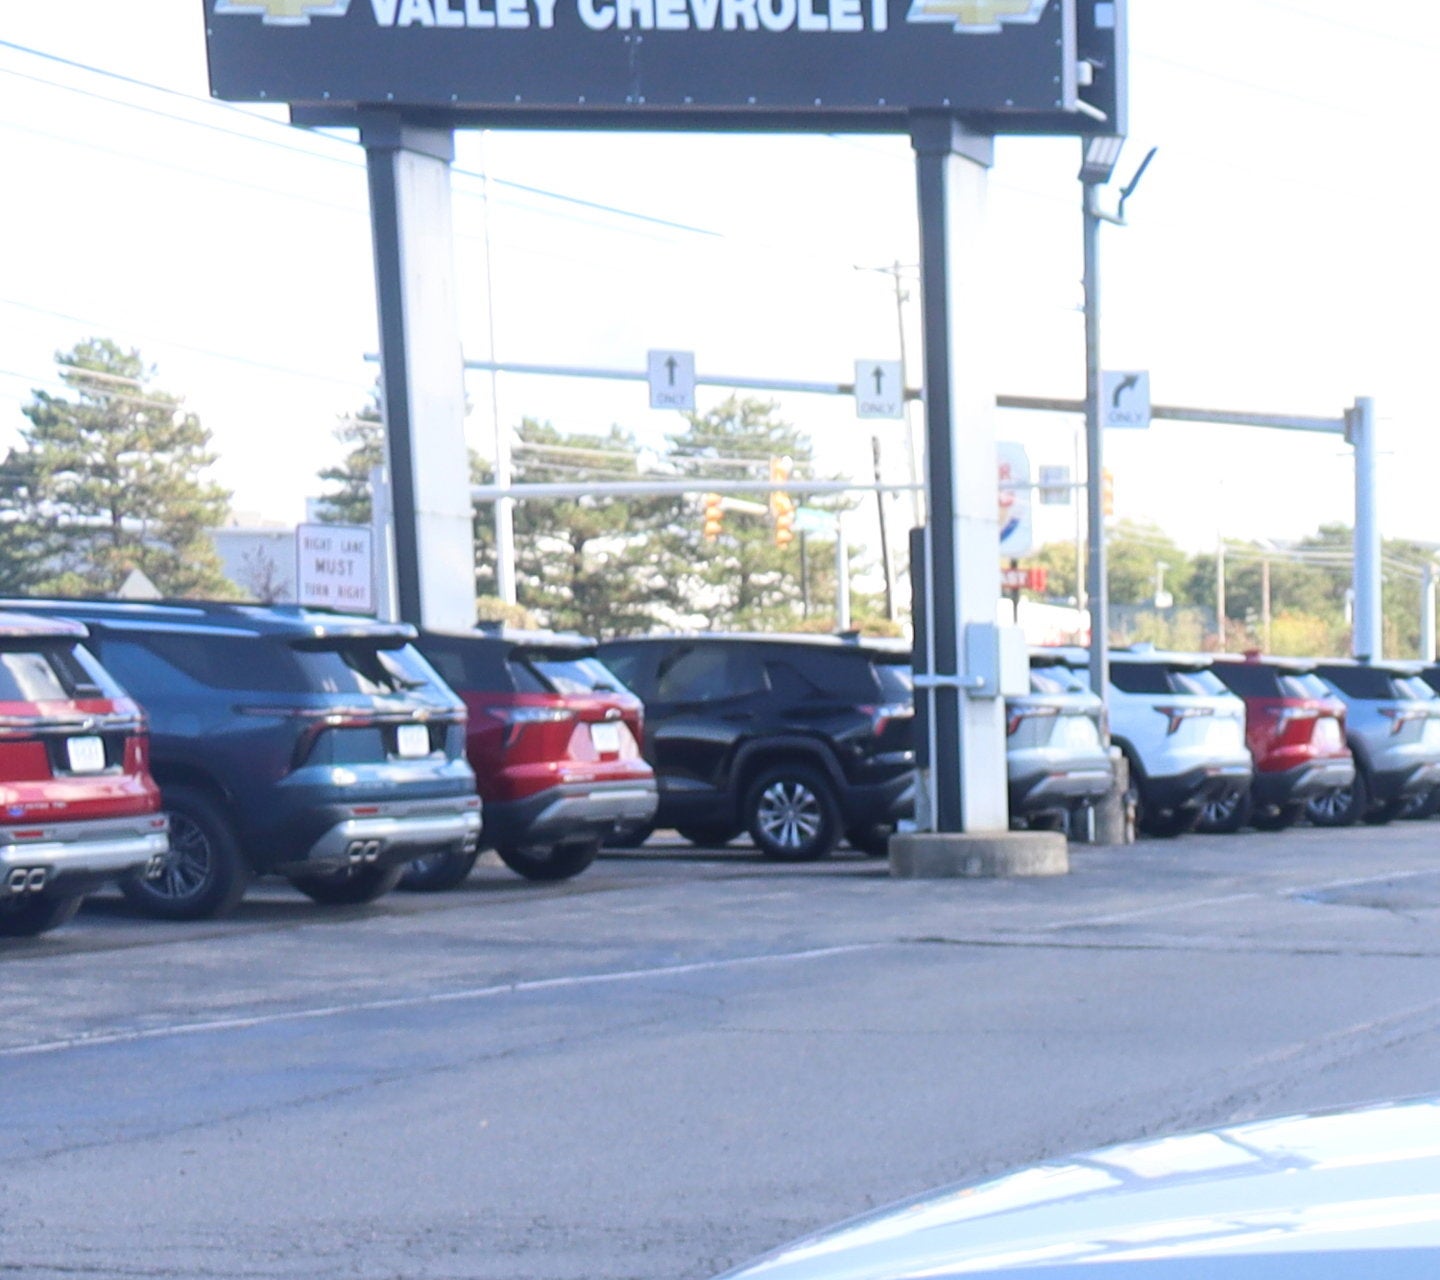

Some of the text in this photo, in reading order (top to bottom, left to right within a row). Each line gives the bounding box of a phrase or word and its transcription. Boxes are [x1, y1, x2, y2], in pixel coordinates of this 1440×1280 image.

[371, 0, 889, 32] VALLEY CHEVROLET
[657, 393, 686, 405] ONLY
[860, 402, 895, 413] ONLY
[1109, 412, 1142, 423] ONLY
[315, 559, 354, 575] MUST
[304, 583, 330, 595] TURN
